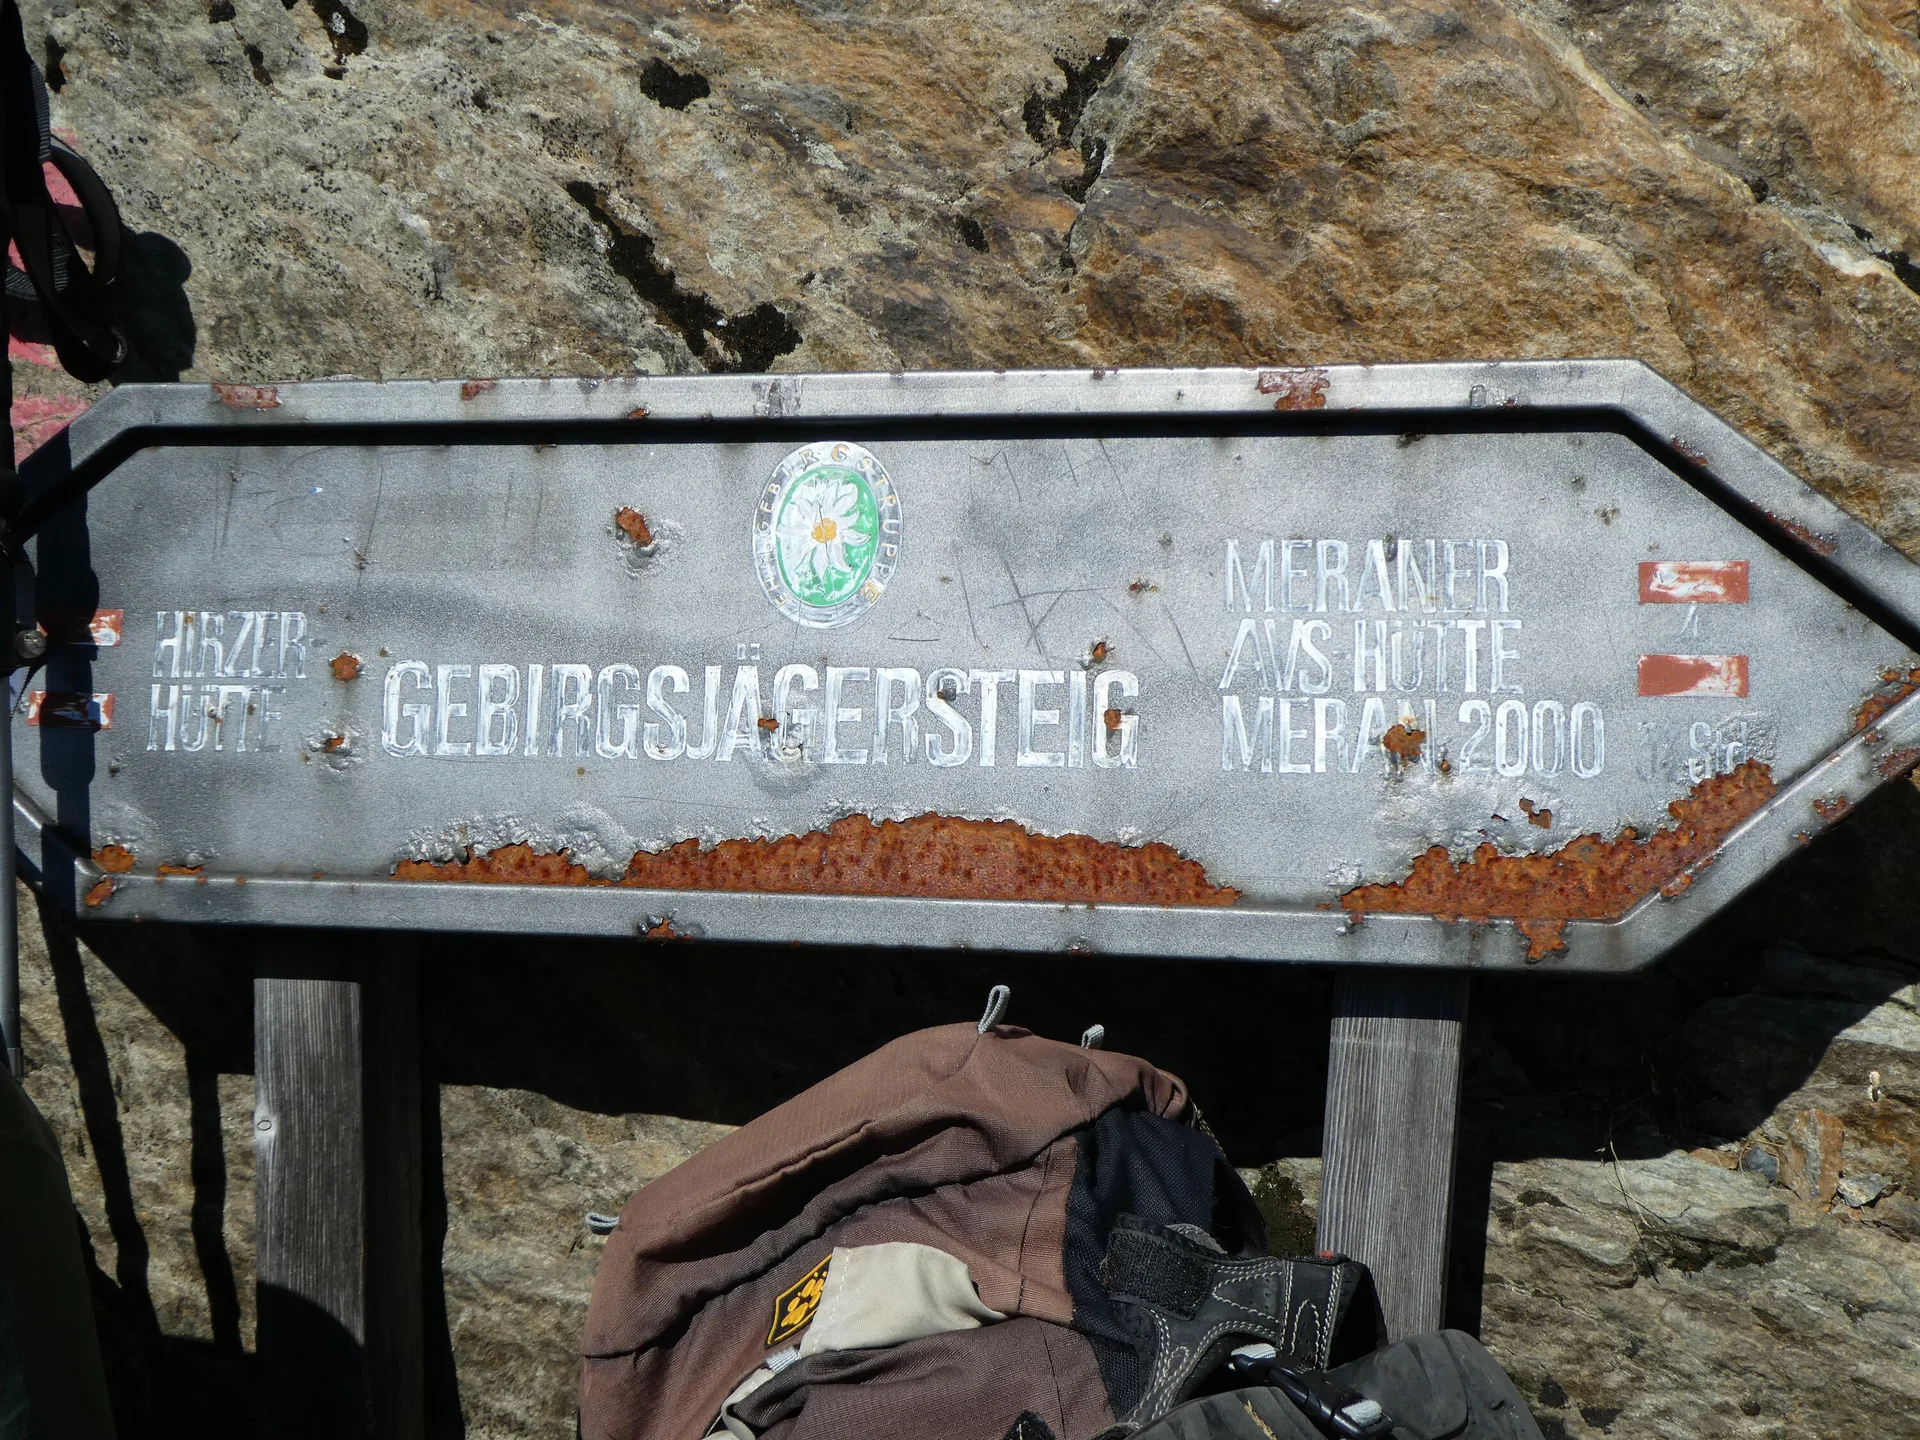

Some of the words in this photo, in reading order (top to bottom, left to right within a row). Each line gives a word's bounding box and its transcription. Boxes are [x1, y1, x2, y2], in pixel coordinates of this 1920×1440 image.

[756, 444, 899, 605] GEBIRGSTRUPPE
[1224, 538, 1510, 613] MERANER
[153, 610, 306, 678] HIRZER
[146, 683, 286, 752] HÜTTE
[381, 643, 1140, 769] GEBIRGSJÄGERSTEIG
[1221, 696, 1436, 774] MERAN
[1458, 699, 1604, 779] 2000
